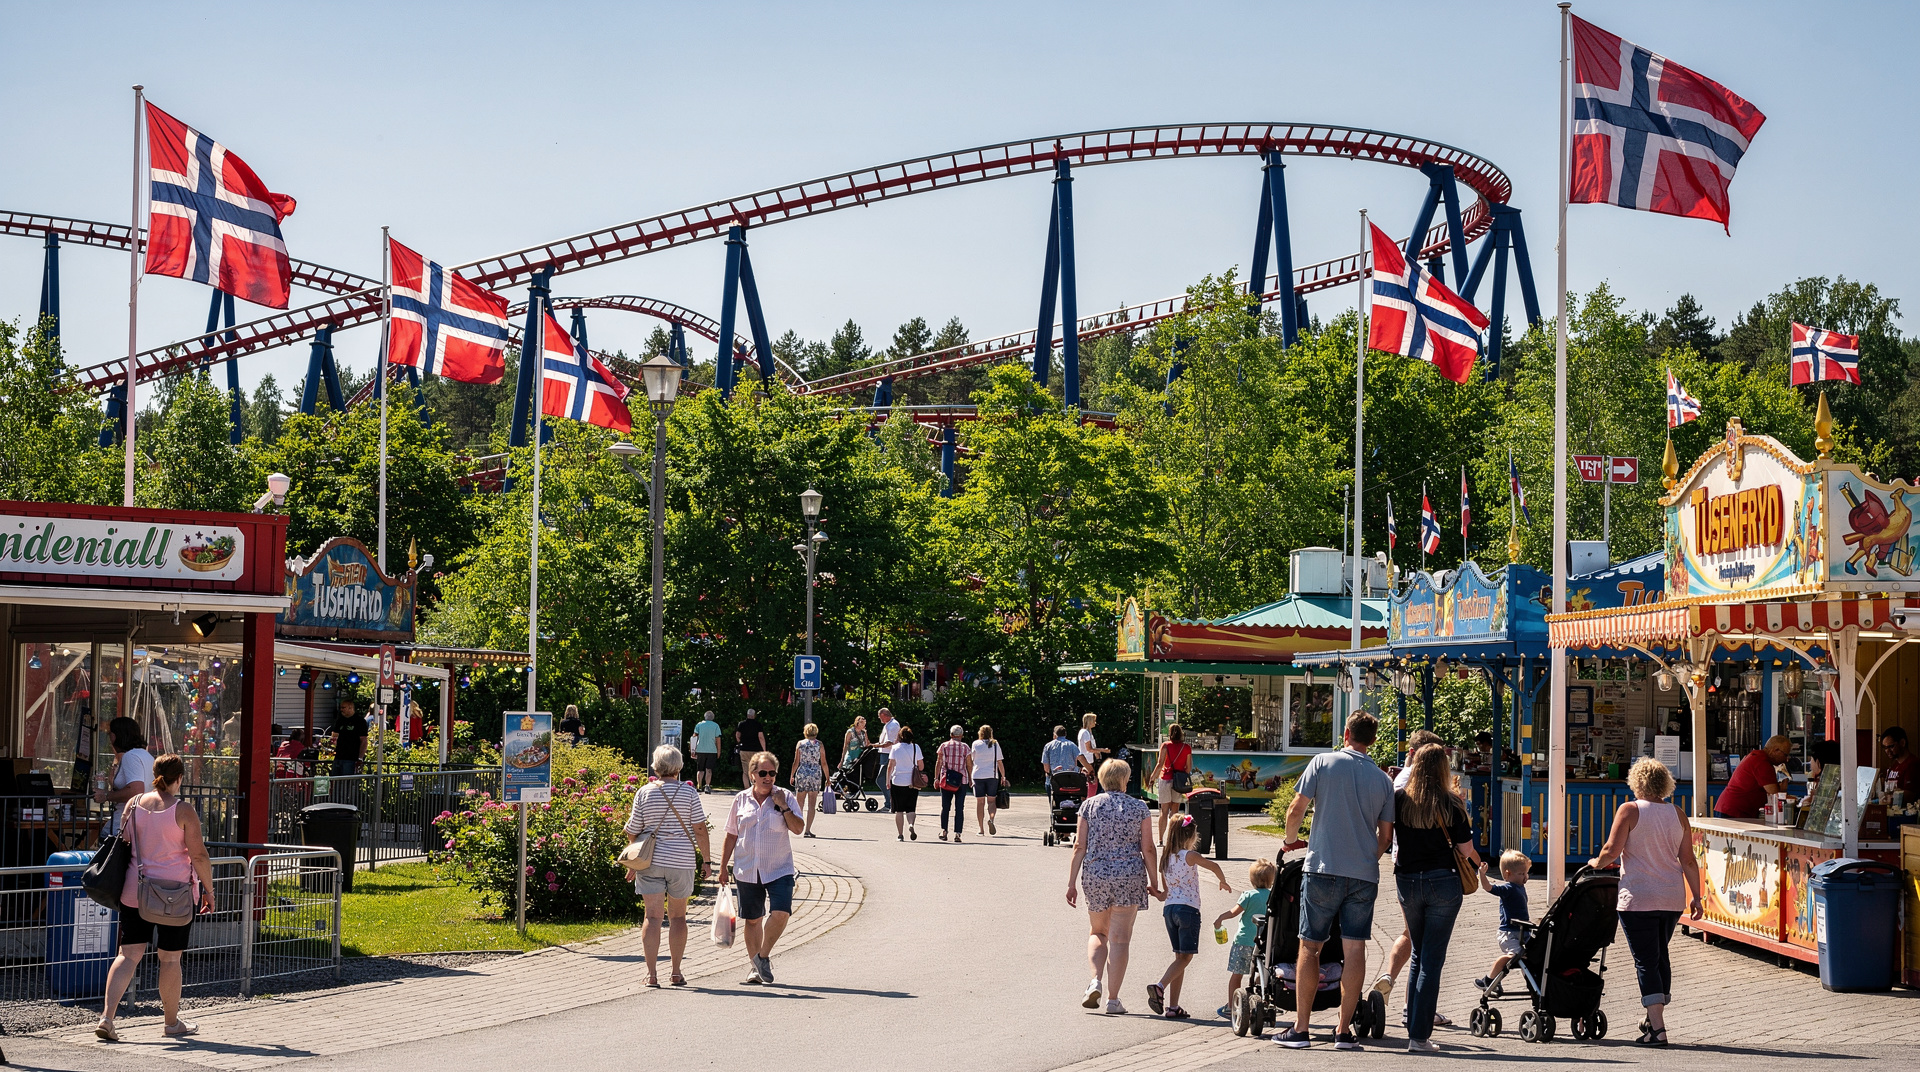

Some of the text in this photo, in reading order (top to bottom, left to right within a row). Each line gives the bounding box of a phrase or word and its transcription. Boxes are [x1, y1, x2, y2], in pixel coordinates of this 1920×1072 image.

[1691, 484, 1784, 557] TUSENFRYD
[312, 572, 383, 621] TUSENFRYD
[800, 659, 816, 680] P
